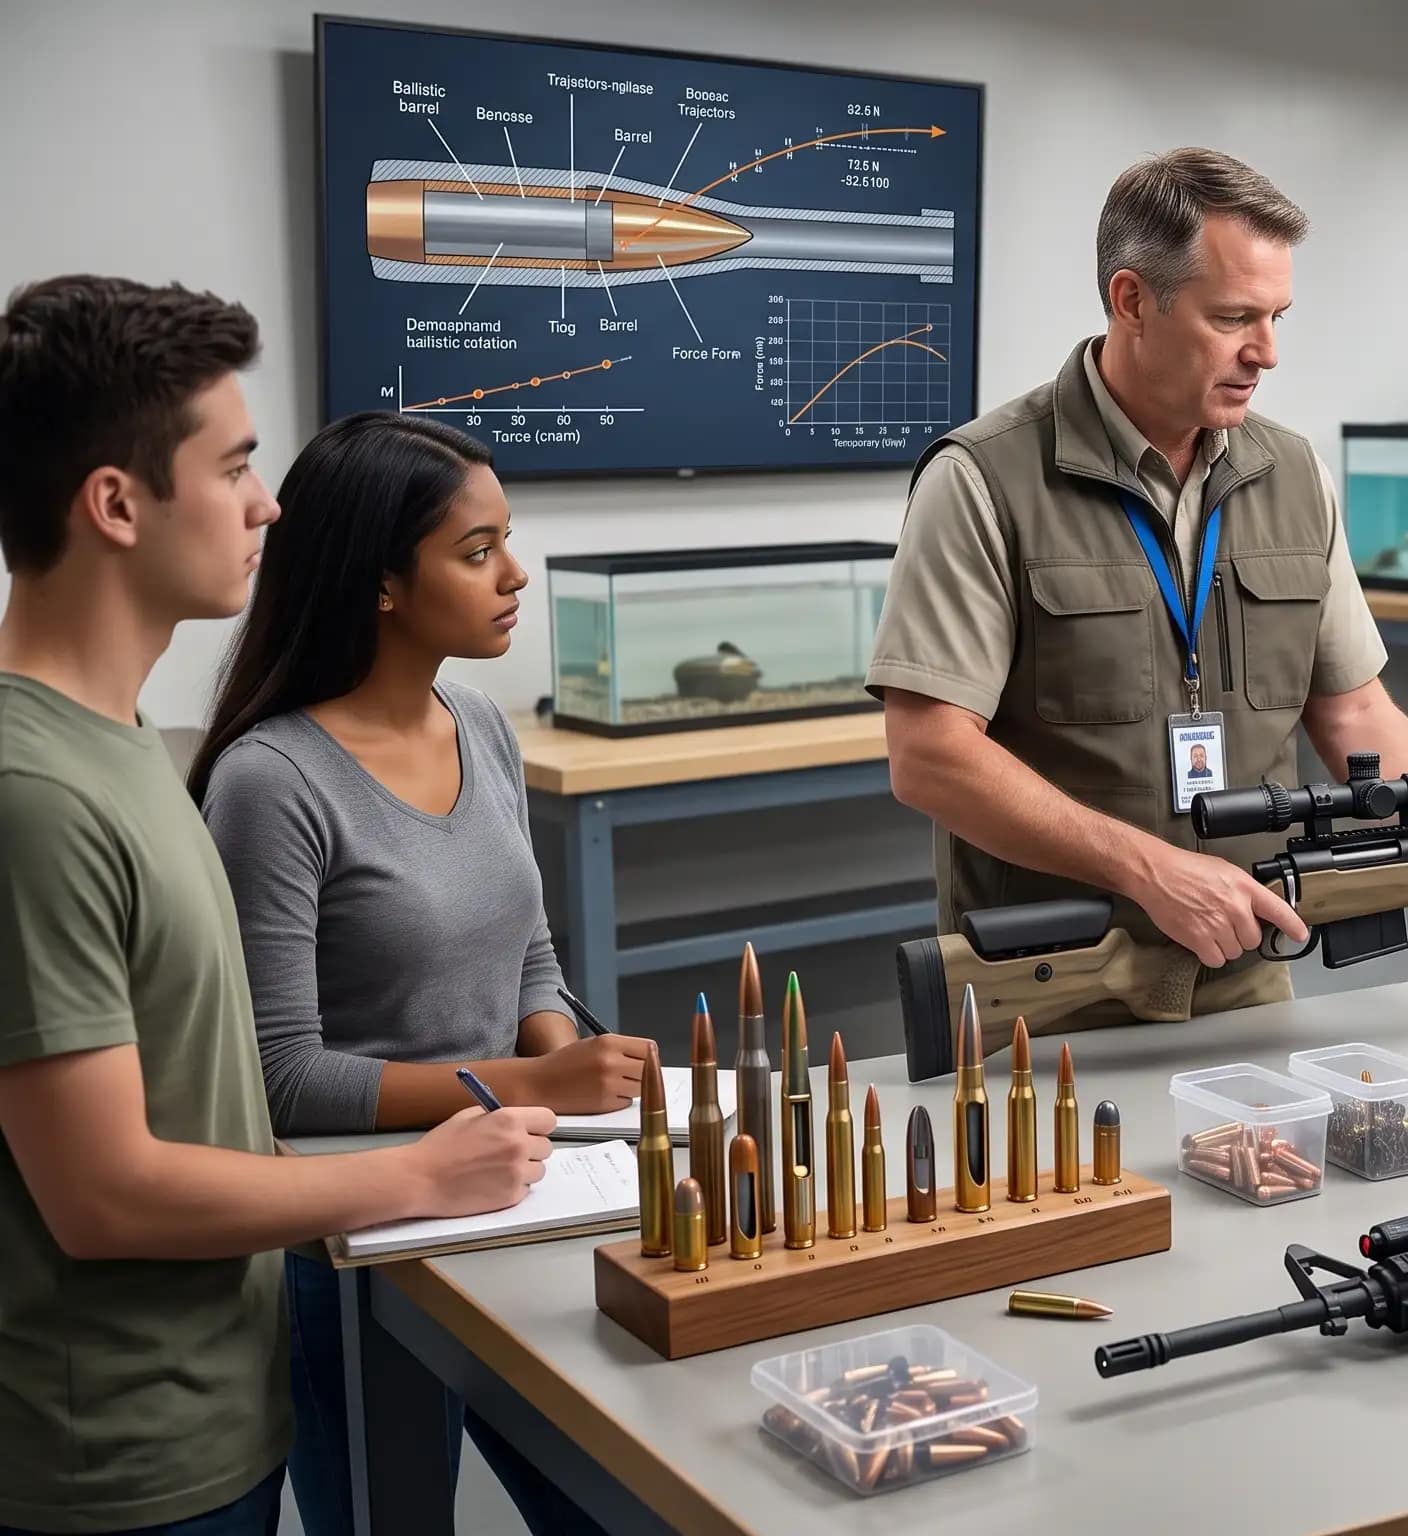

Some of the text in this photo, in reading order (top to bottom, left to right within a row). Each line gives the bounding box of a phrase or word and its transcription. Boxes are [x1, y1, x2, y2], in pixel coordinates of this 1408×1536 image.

[393, 80, 446, 98] Ballistic
[399, 97, 439, 115] barrel
[677, 103, 737, 120] Trajectors
[873, 105, 881, 117] N
[614, 128, 652, 144] Barrel
[872, 161, 880, 172] N
[599, 318, 639, 332] Barrel
[672, 346, 709, 360] Force
[380, 386, 394, 398] M
[466, 415, 482, 426] 30
[556, 415, 571, 426] 60
[535, 429, 581, 445] (cnam)
[785, 428, 791, 437] 0
